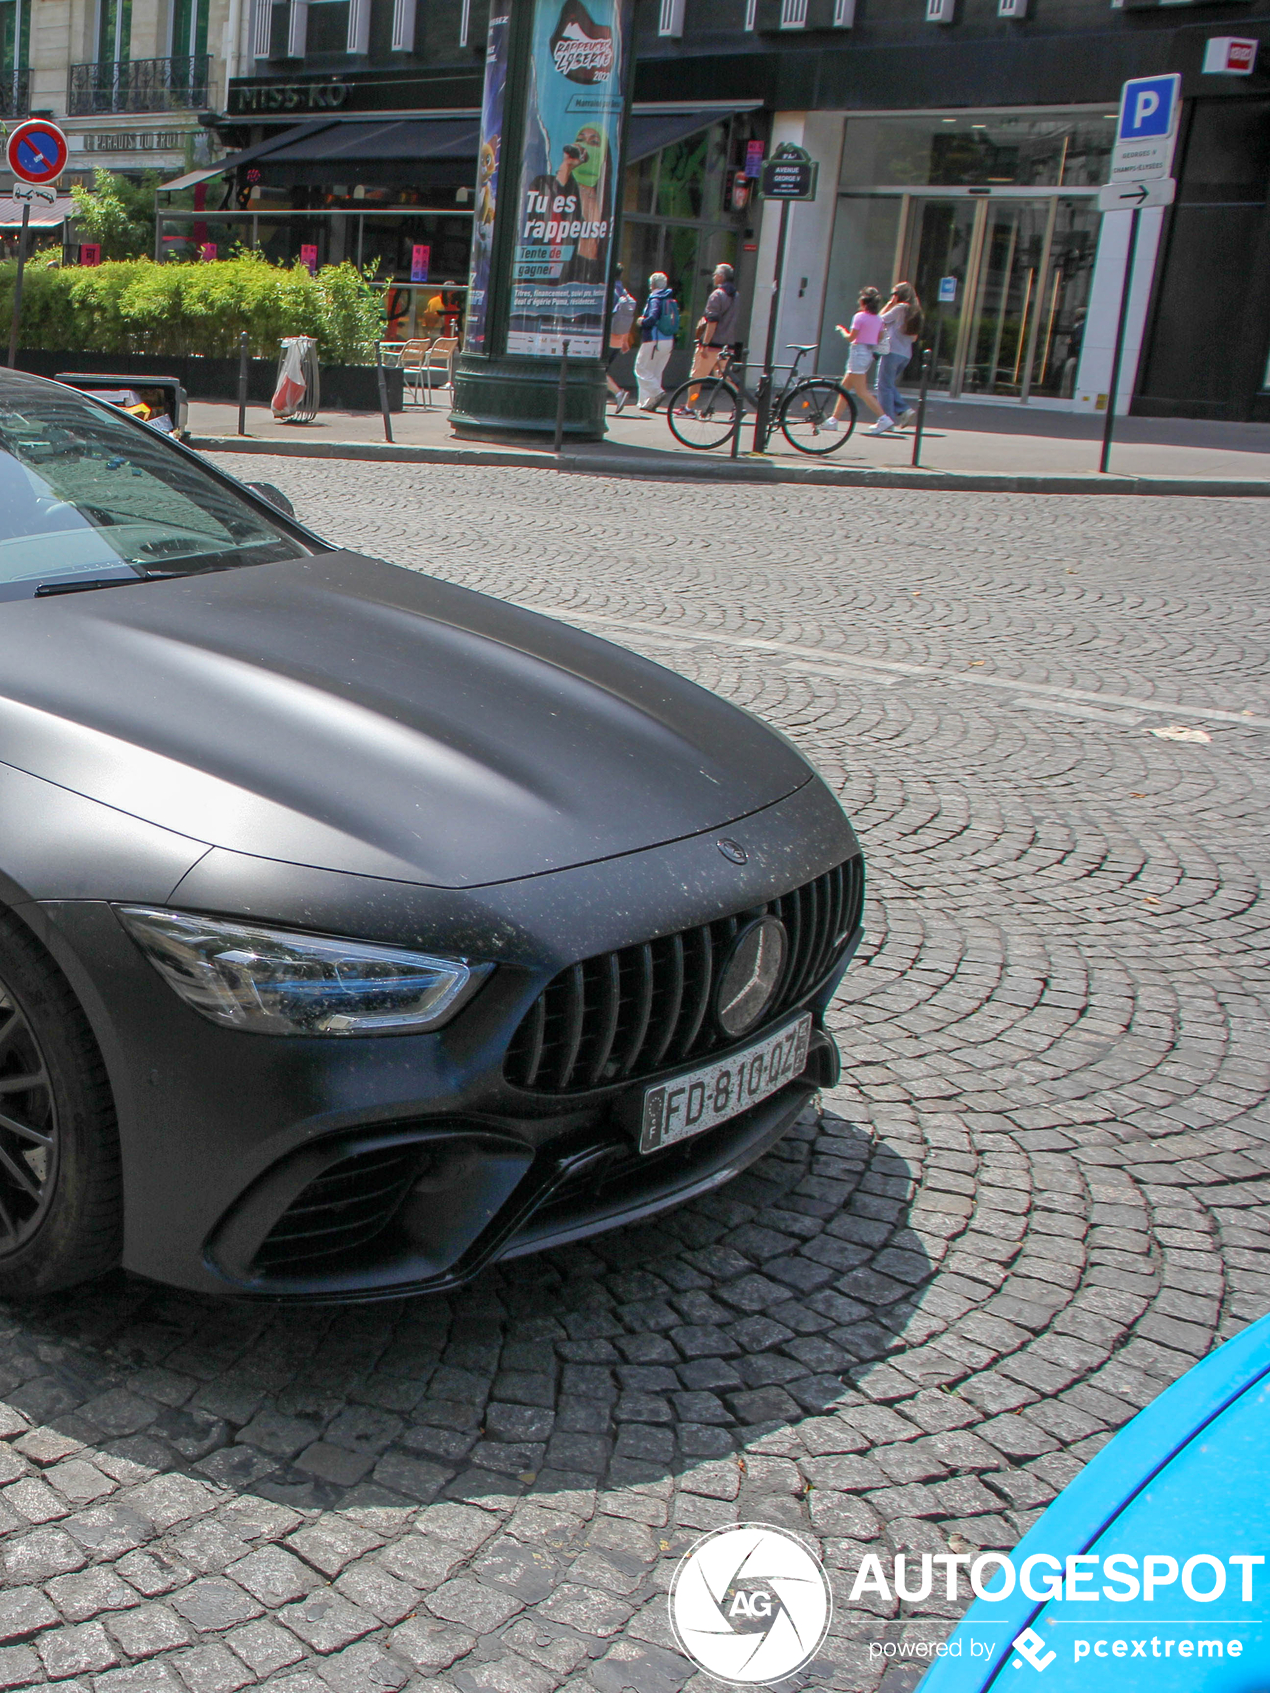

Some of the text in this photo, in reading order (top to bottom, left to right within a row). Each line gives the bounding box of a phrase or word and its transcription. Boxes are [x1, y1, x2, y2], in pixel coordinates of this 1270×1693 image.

[239, 84, 299, 109] MISS
[1133, 91, 1160, 129] P
[96, 134, 134, 150] PARADIS
[526, 190, 577, 213] Tu es
[521, 248, 562, 259] Tente de
[518, 265, 554, 277] gagner
